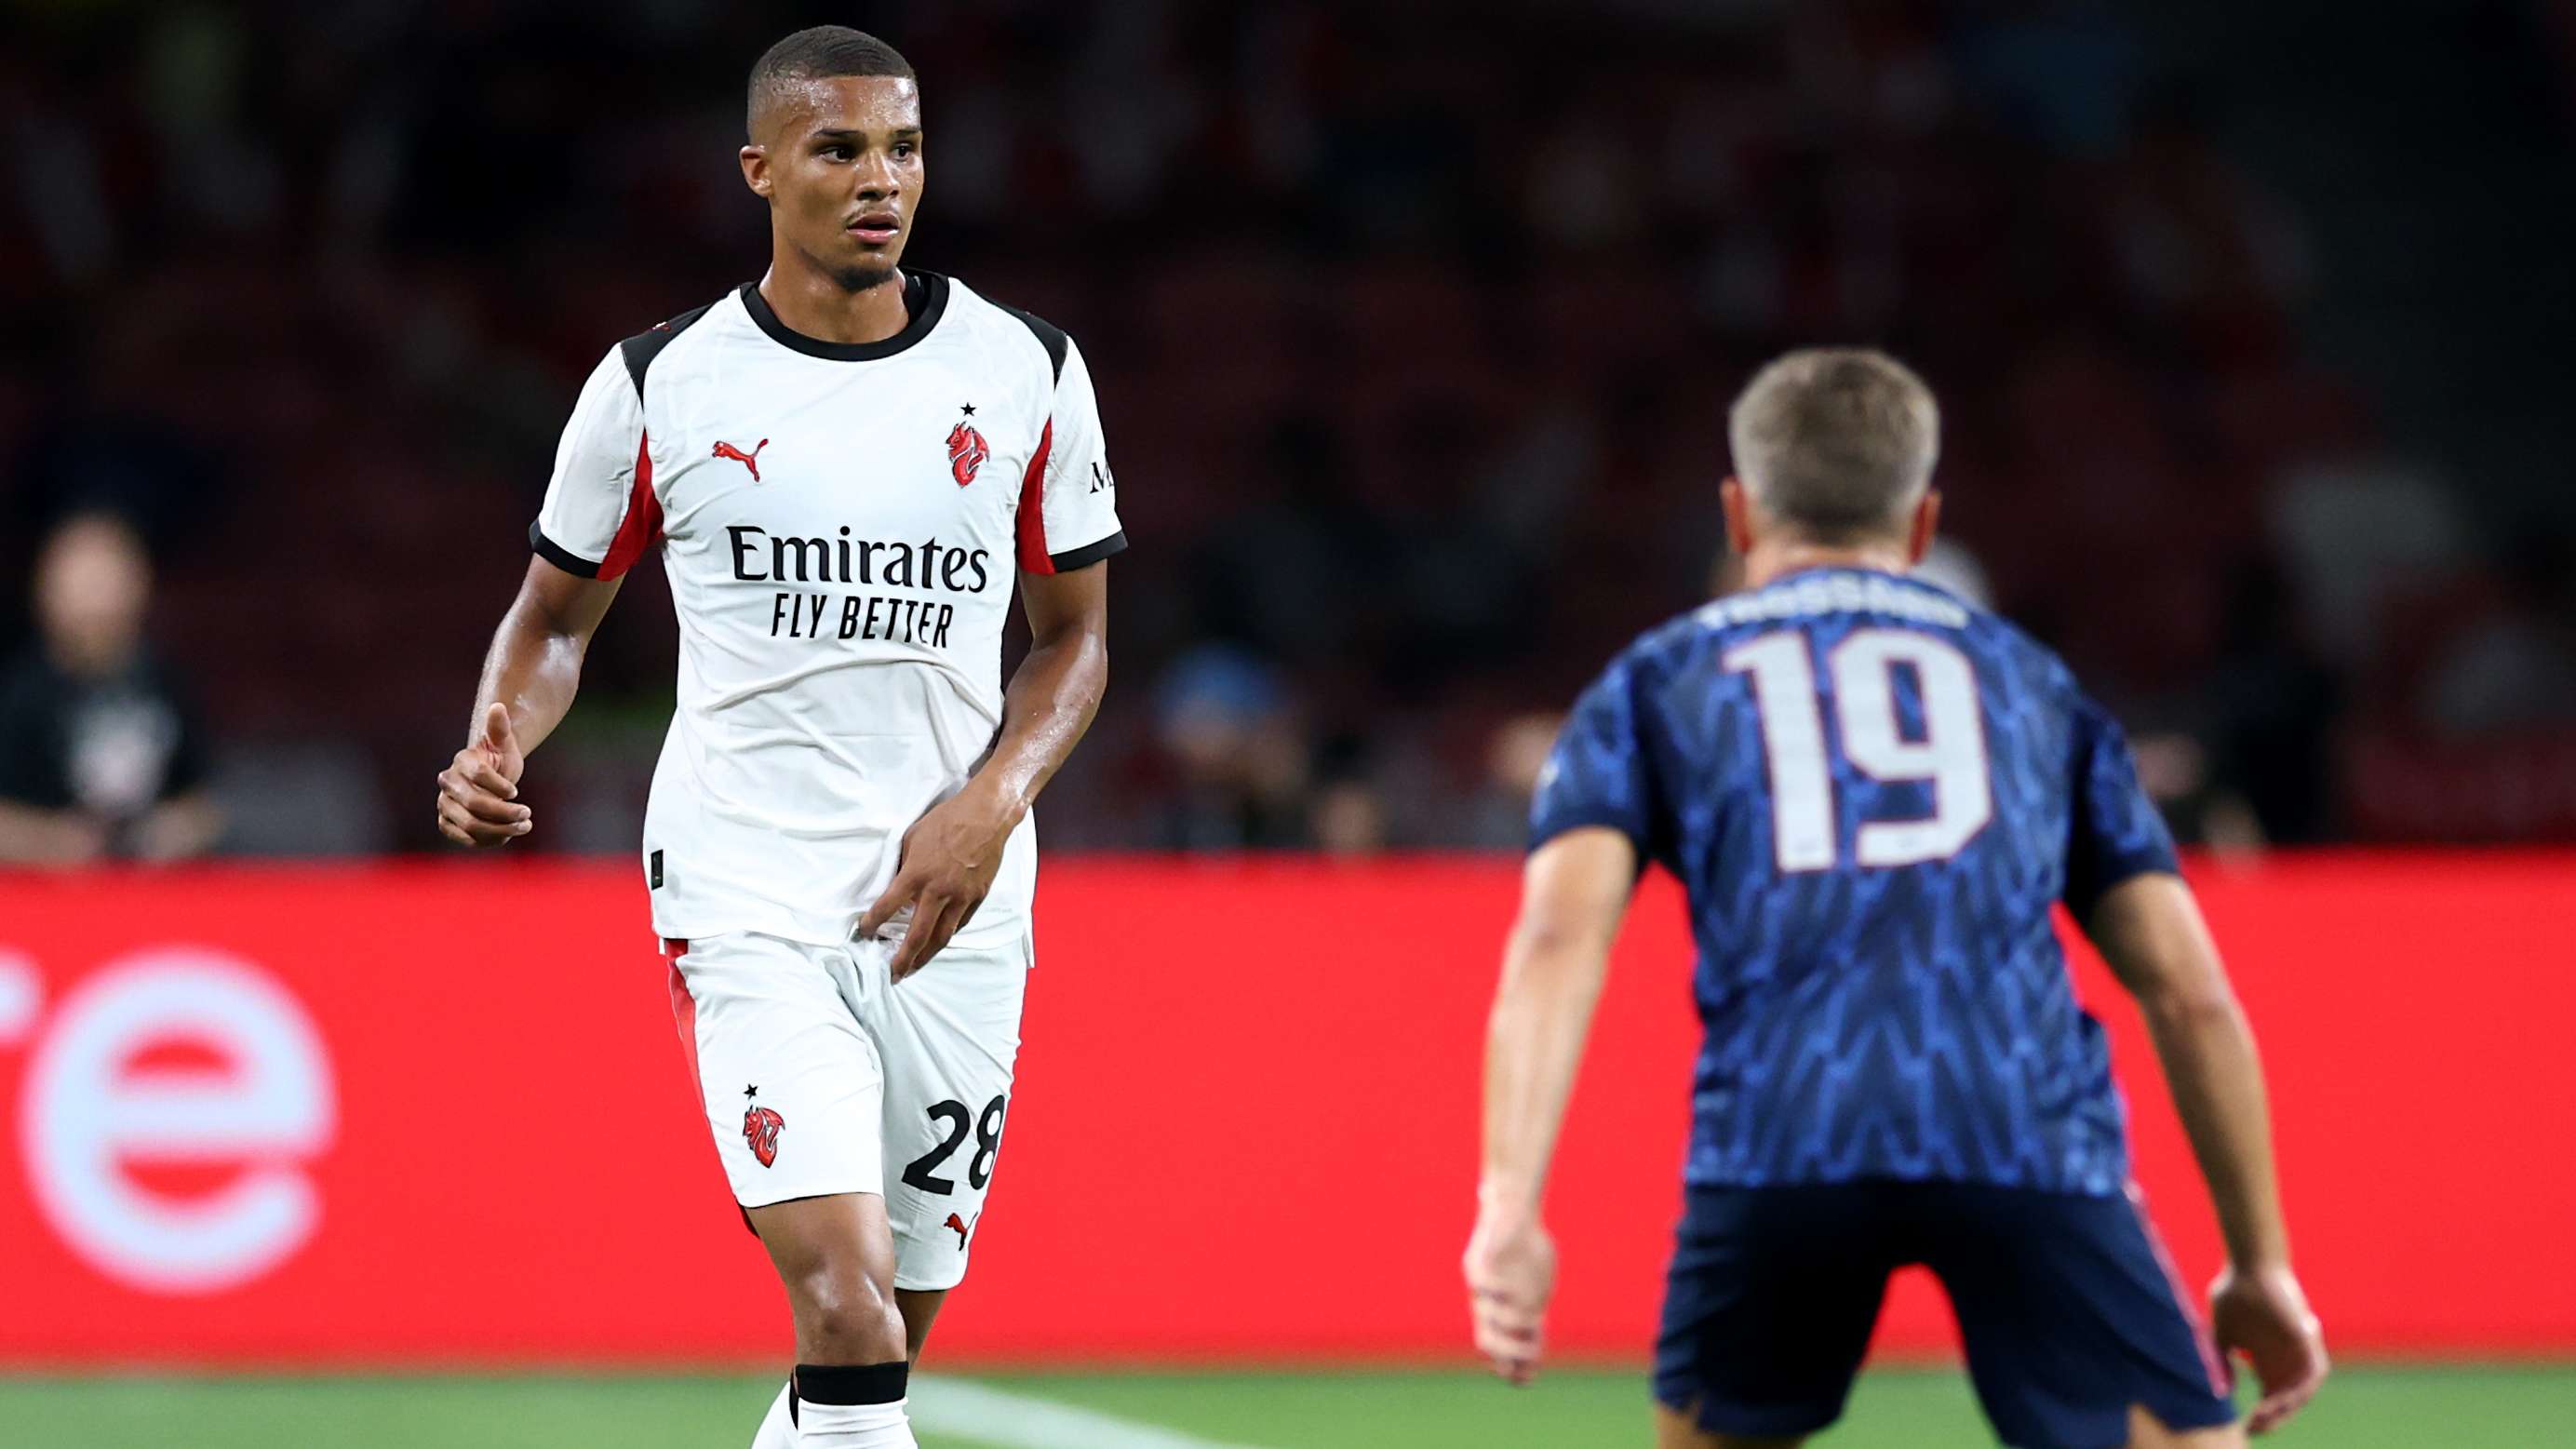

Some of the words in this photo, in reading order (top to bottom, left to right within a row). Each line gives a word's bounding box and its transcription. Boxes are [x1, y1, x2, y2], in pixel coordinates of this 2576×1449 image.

[726, 525, 989, 593] Emirates
[771, 593, 826, 638] FLY
[838, 596, 954, 649] BETTER
[1723, 628, 1992, 873] 19
[901, 1094, 1005, 1196] 28
